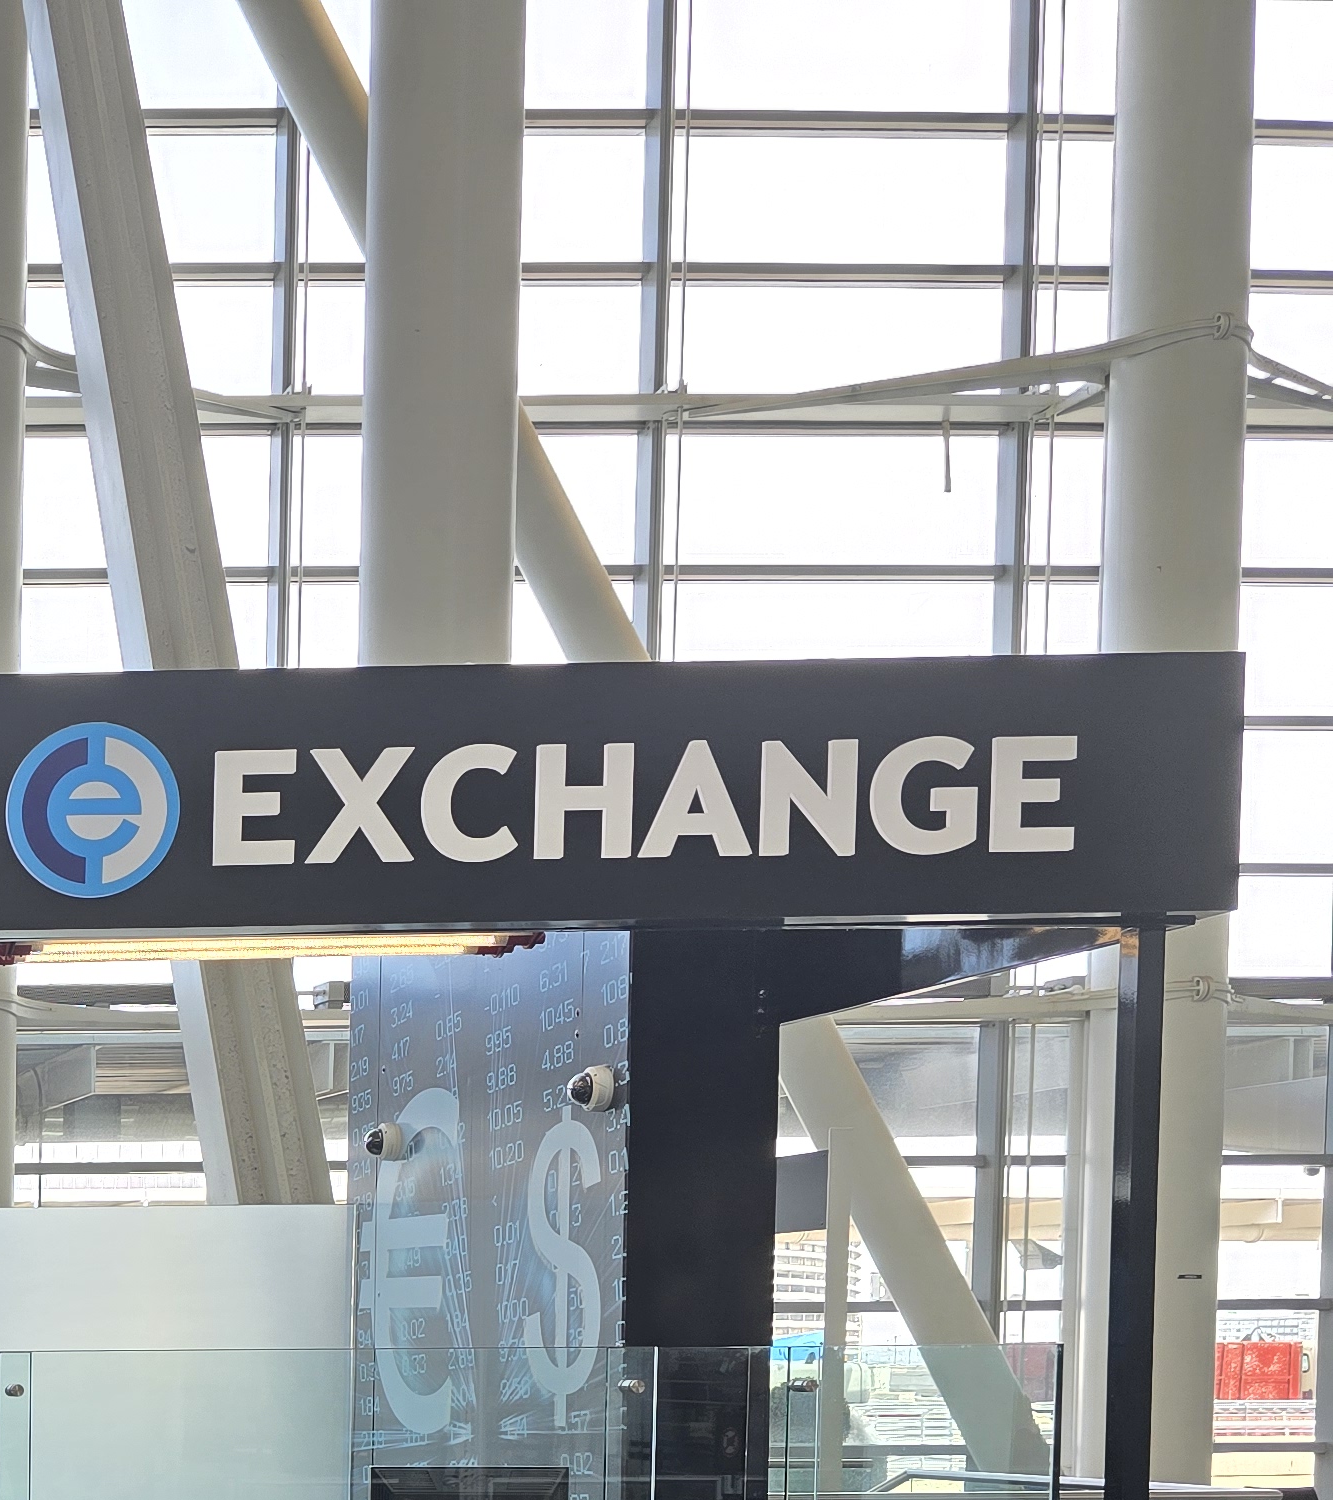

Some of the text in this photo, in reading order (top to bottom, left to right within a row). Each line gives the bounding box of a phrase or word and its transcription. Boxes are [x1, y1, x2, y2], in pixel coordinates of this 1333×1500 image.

[211, 734, 1079, 868] EXCHANGE
[540, 960, 567, 993] 6.31
[390, 1000, 413, 1028] 3.24
[435, 1010, 462, 1041] 0.85
[485, 1025, 512, 1055] 995
[541, 1040, 574, 1071] 4.88
[543, 1085, 573, 1112] 5.2
[487, 1101, 523, 1132] 10.05
[489, 1140, 524, 1171] 10.20
[494, 1220, 520, 1246] 0.01
